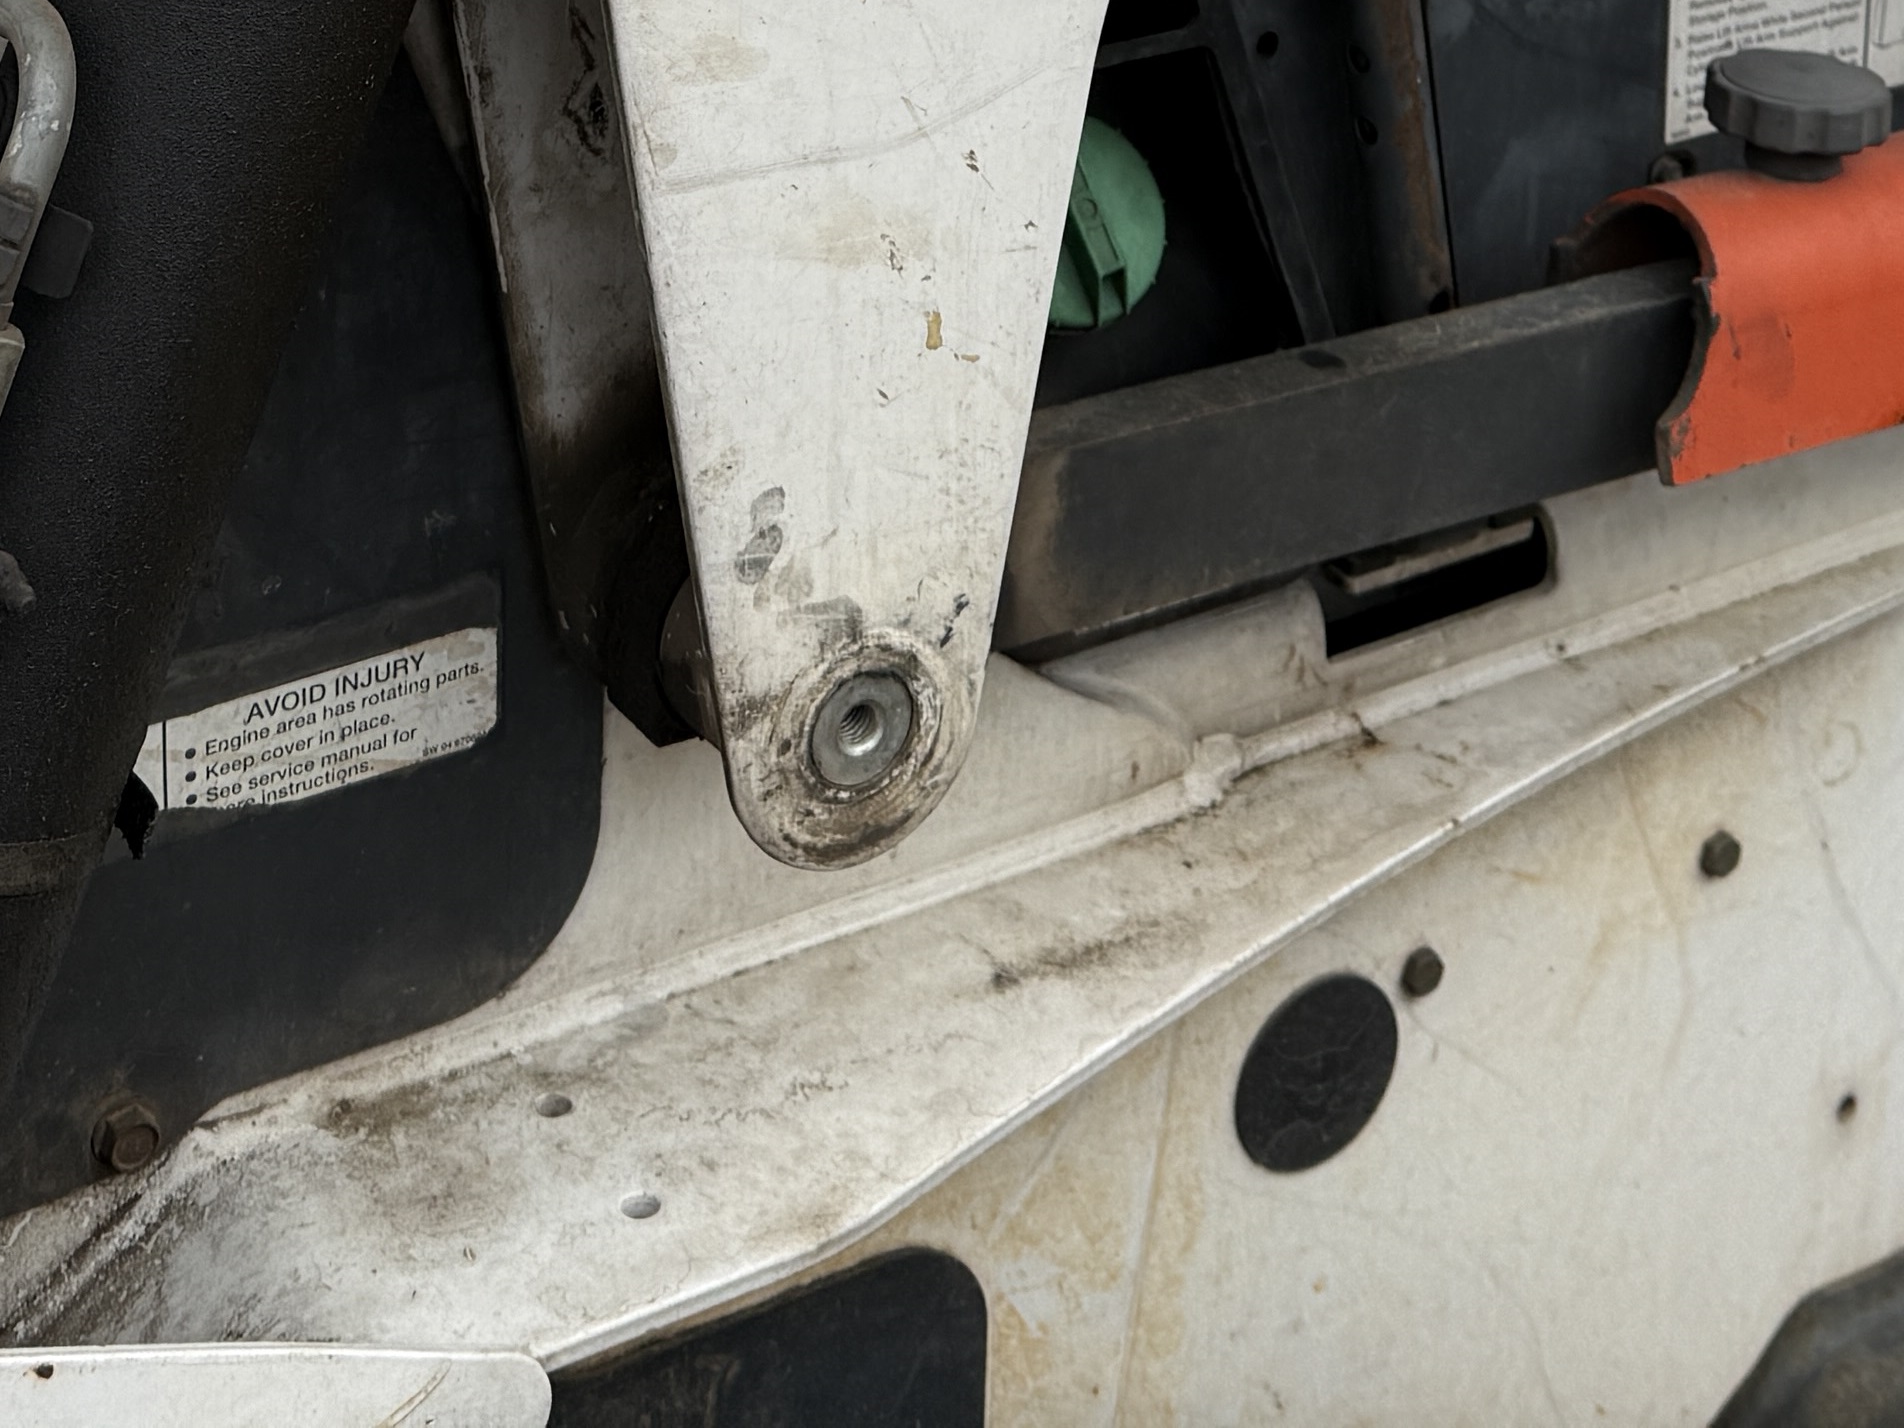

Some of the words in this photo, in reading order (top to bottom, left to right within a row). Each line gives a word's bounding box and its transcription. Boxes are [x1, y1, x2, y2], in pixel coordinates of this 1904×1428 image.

[205, 726, 269, 756] Engine
[276, 712, 316, 734] area
[322, 700, 355, 720] has
[361, 677, 430, 707] rotating
[435, 662, 483, 688] parts.
[246, 683, 326, 723] AVOID
[334, 651, 424, 696] INJURY
[205, 754, 254, 780] Keep
[260, 736, 313, 762] cover
[318, 729, 334, 745] in
[339, 713, 395, 741] place.
[205, 782, 241, 802] See
[248, 760, 314, 789] service
[320, 733, 387, 767] manual
[392, 727, 417, 744] for
[261, 761, 373, 805] instructions.
